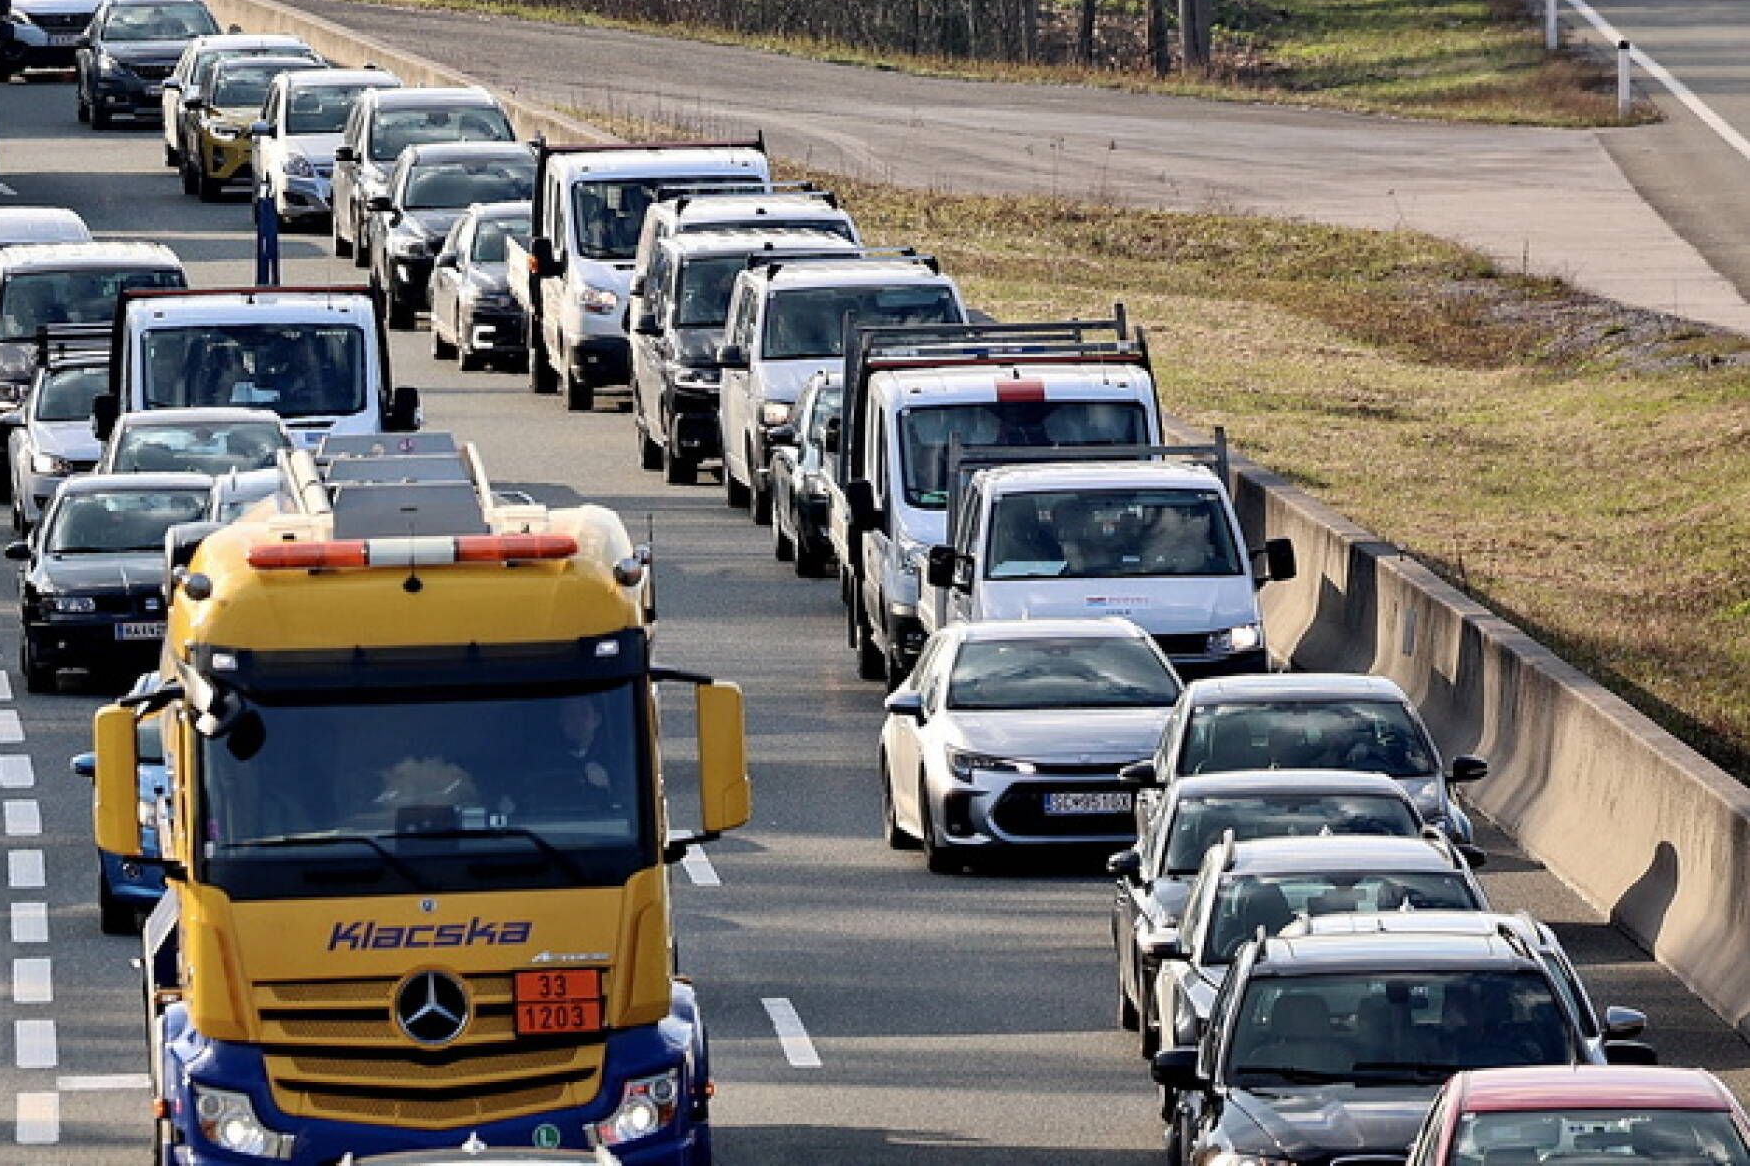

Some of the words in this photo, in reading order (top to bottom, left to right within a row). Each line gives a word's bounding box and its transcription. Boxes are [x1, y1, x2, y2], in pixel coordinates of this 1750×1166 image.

[327, 916, 533, 951] Klacska
[538, 975, 566, 998] 33
[525, 1006, 584, 1030] 1203
